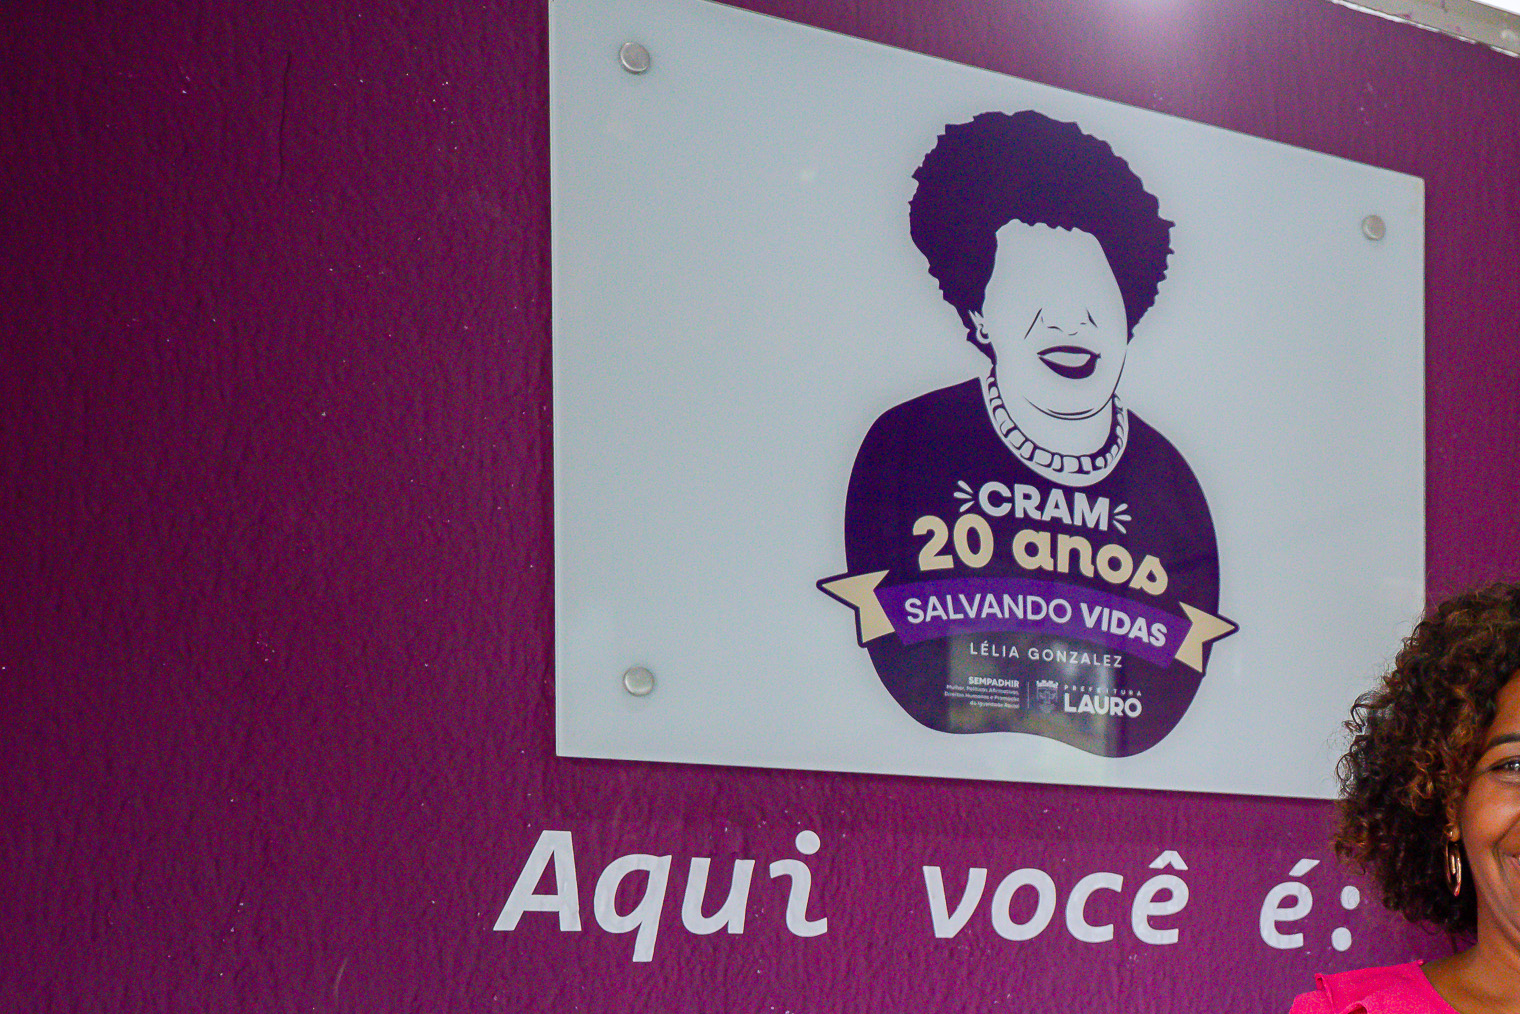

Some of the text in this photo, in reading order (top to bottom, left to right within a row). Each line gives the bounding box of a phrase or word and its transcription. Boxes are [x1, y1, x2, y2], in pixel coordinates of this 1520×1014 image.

[978, 481, 1109, 531] CRAM
[912, 513, 994, 571] 20
[904, 593, 1168, 648] SALVANDO VIDAS
[969, 641, 1122, 668] LÉLIA GONZALEZ
[968, 676, 1020, 688] SEMPADHIR
[1064, 685, 1142, 697] PREFEITURA
[1064, 692, 1143, 718] LAURO
[493, 829, 1362, 963] Aqui você é:
